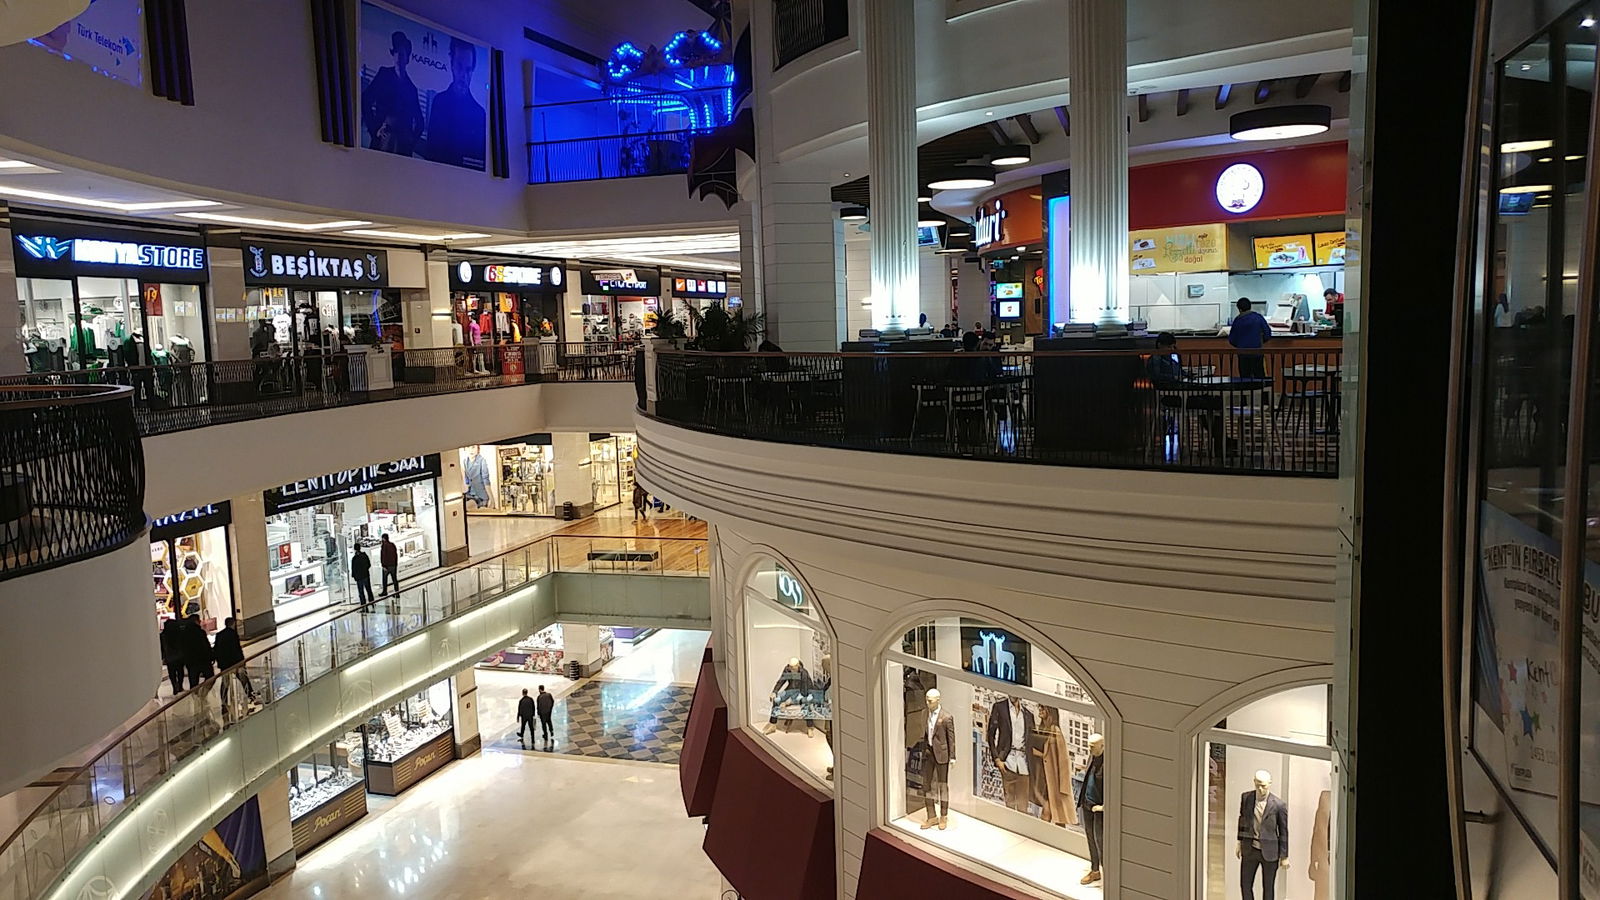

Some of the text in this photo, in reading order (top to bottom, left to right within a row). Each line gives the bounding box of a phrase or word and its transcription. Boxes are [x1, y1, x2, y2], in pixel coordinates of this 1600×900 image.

[77, 22, 124, 55] Türk Telekom
[411, 53, 448, 72] KARACA
[271, 249, 363, 281] BEŞİKTAŞ
[1184, 254, 1203, 265] doğal
[350, 483, 374, 495] PLAZA
